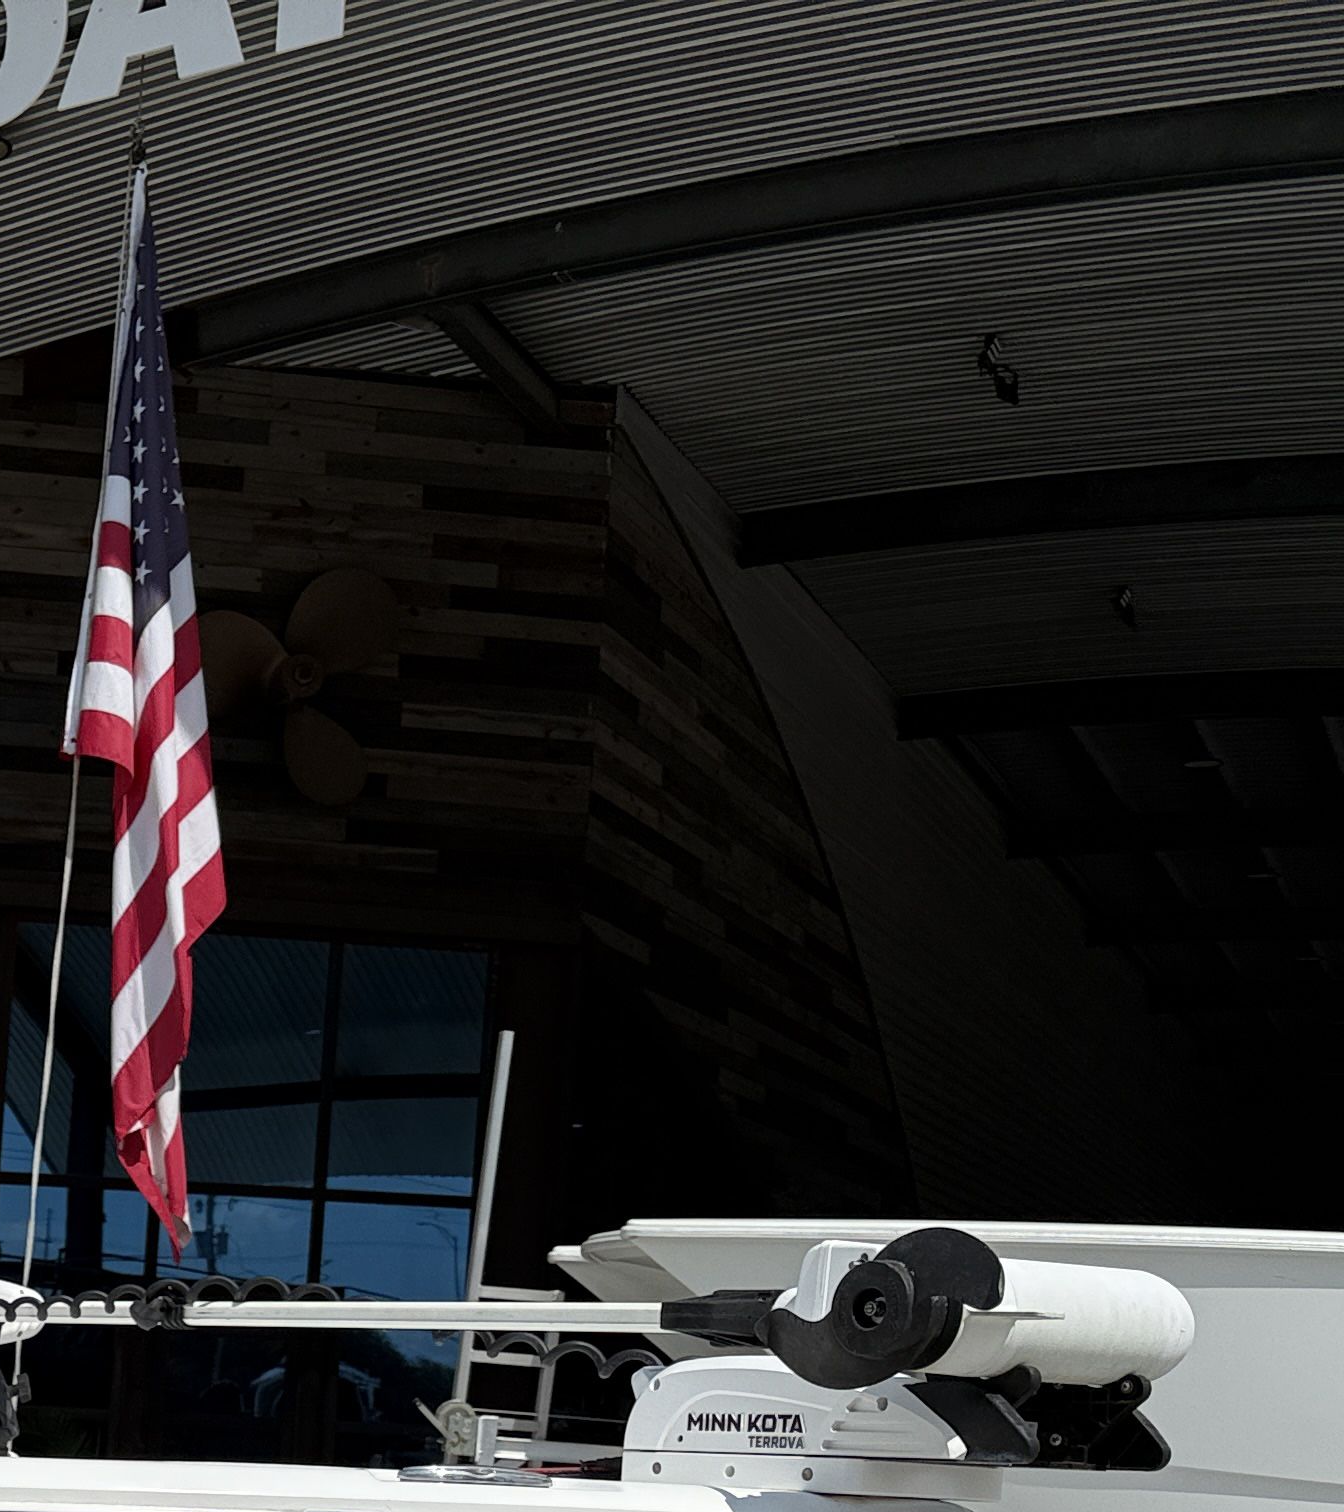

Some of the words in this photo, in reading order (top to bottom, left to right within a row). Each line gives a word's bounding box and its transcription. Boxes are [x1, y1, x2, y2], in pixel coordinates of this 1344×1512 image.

[686, 1413, 742, 1432] MINN
[747, 1414, 805, 1433] KOTA
[748, 1435, 805, 1450] TERROVA
